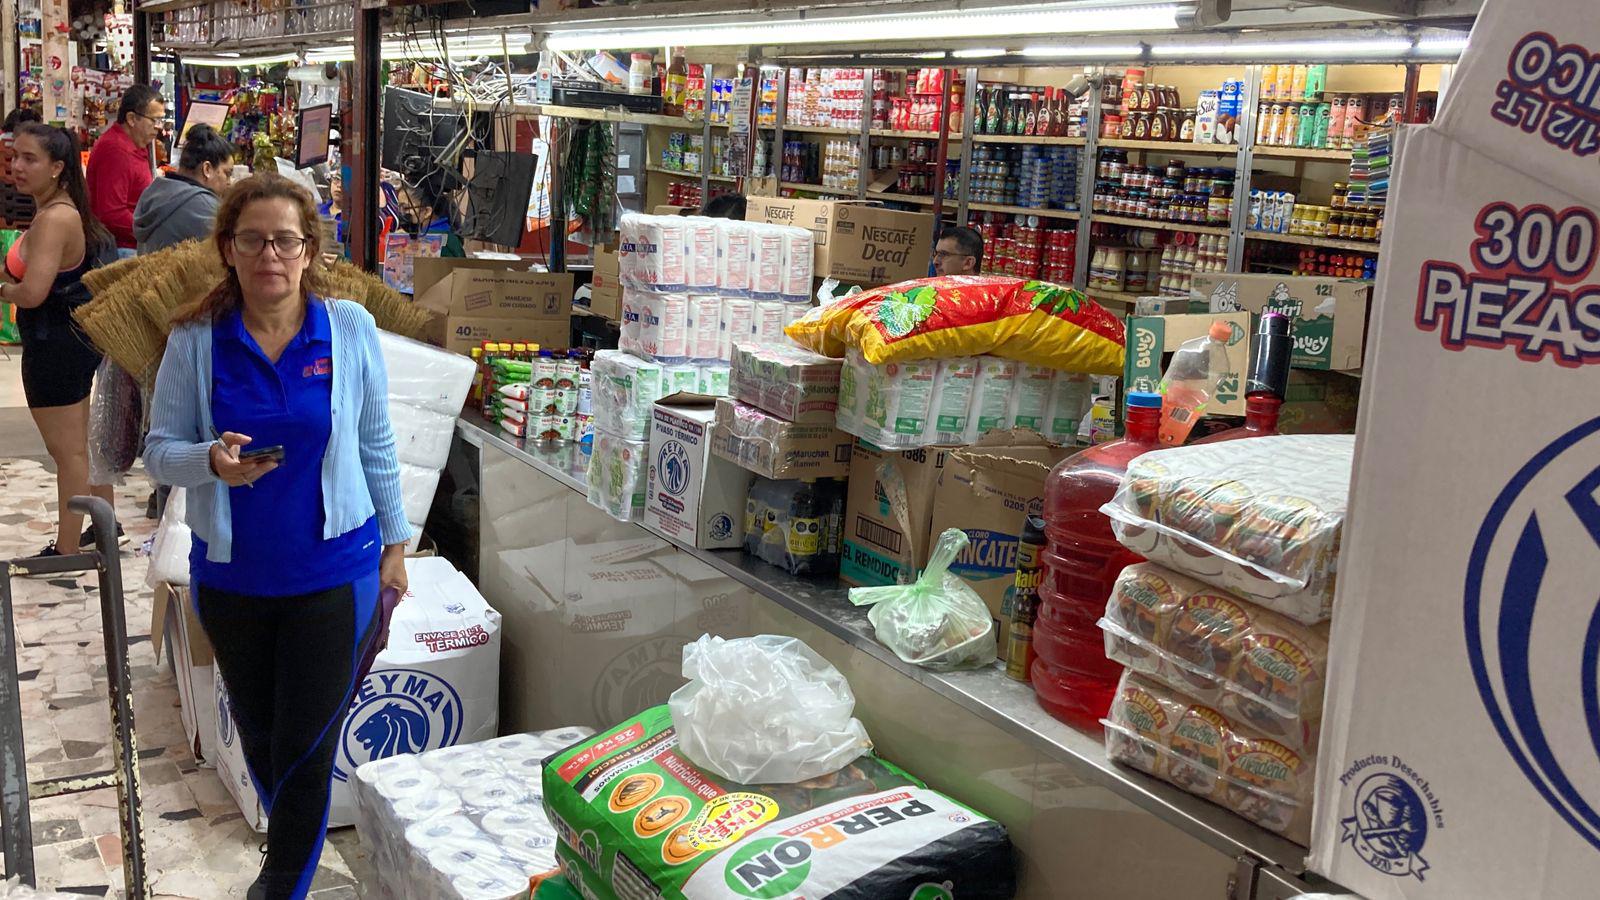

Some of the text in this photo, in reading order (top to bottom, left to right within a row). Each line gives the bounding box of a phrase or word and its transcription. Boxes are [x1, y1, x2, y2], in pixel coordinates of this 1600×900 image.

[1515, 39, 1600, 108] ICO
[1496, 86, 1596, 150] 1/2 LT.
[862, 225, 917, 246] NESCAFÉ
[1479, 209, 1593, 273] 300
[861, 243, 912, 267] Decaf
[1315, 284, 1327, 296] 12
[1423, 268, 1600, 358] PIEZAS
[456, 326, 472, 337] 40
[1215, 379, 1239, 405] 12
[968, 530, 990, 539] CLORO
[1015, 569, 1043, 588] Raid
[416, 631, 458, 642] ENVASE
[427, 632, 489, 652] TERMICO
[349, 673, 445, 713] EYMA
[634, 727, 673, 754] MENOR
[662, 755, 701, 787] Nutrición
[697, 783, 718, 800] que
[1338, 753, 1446, 829] Productos Desechables
[734, 799, 937, 890] PERRON
